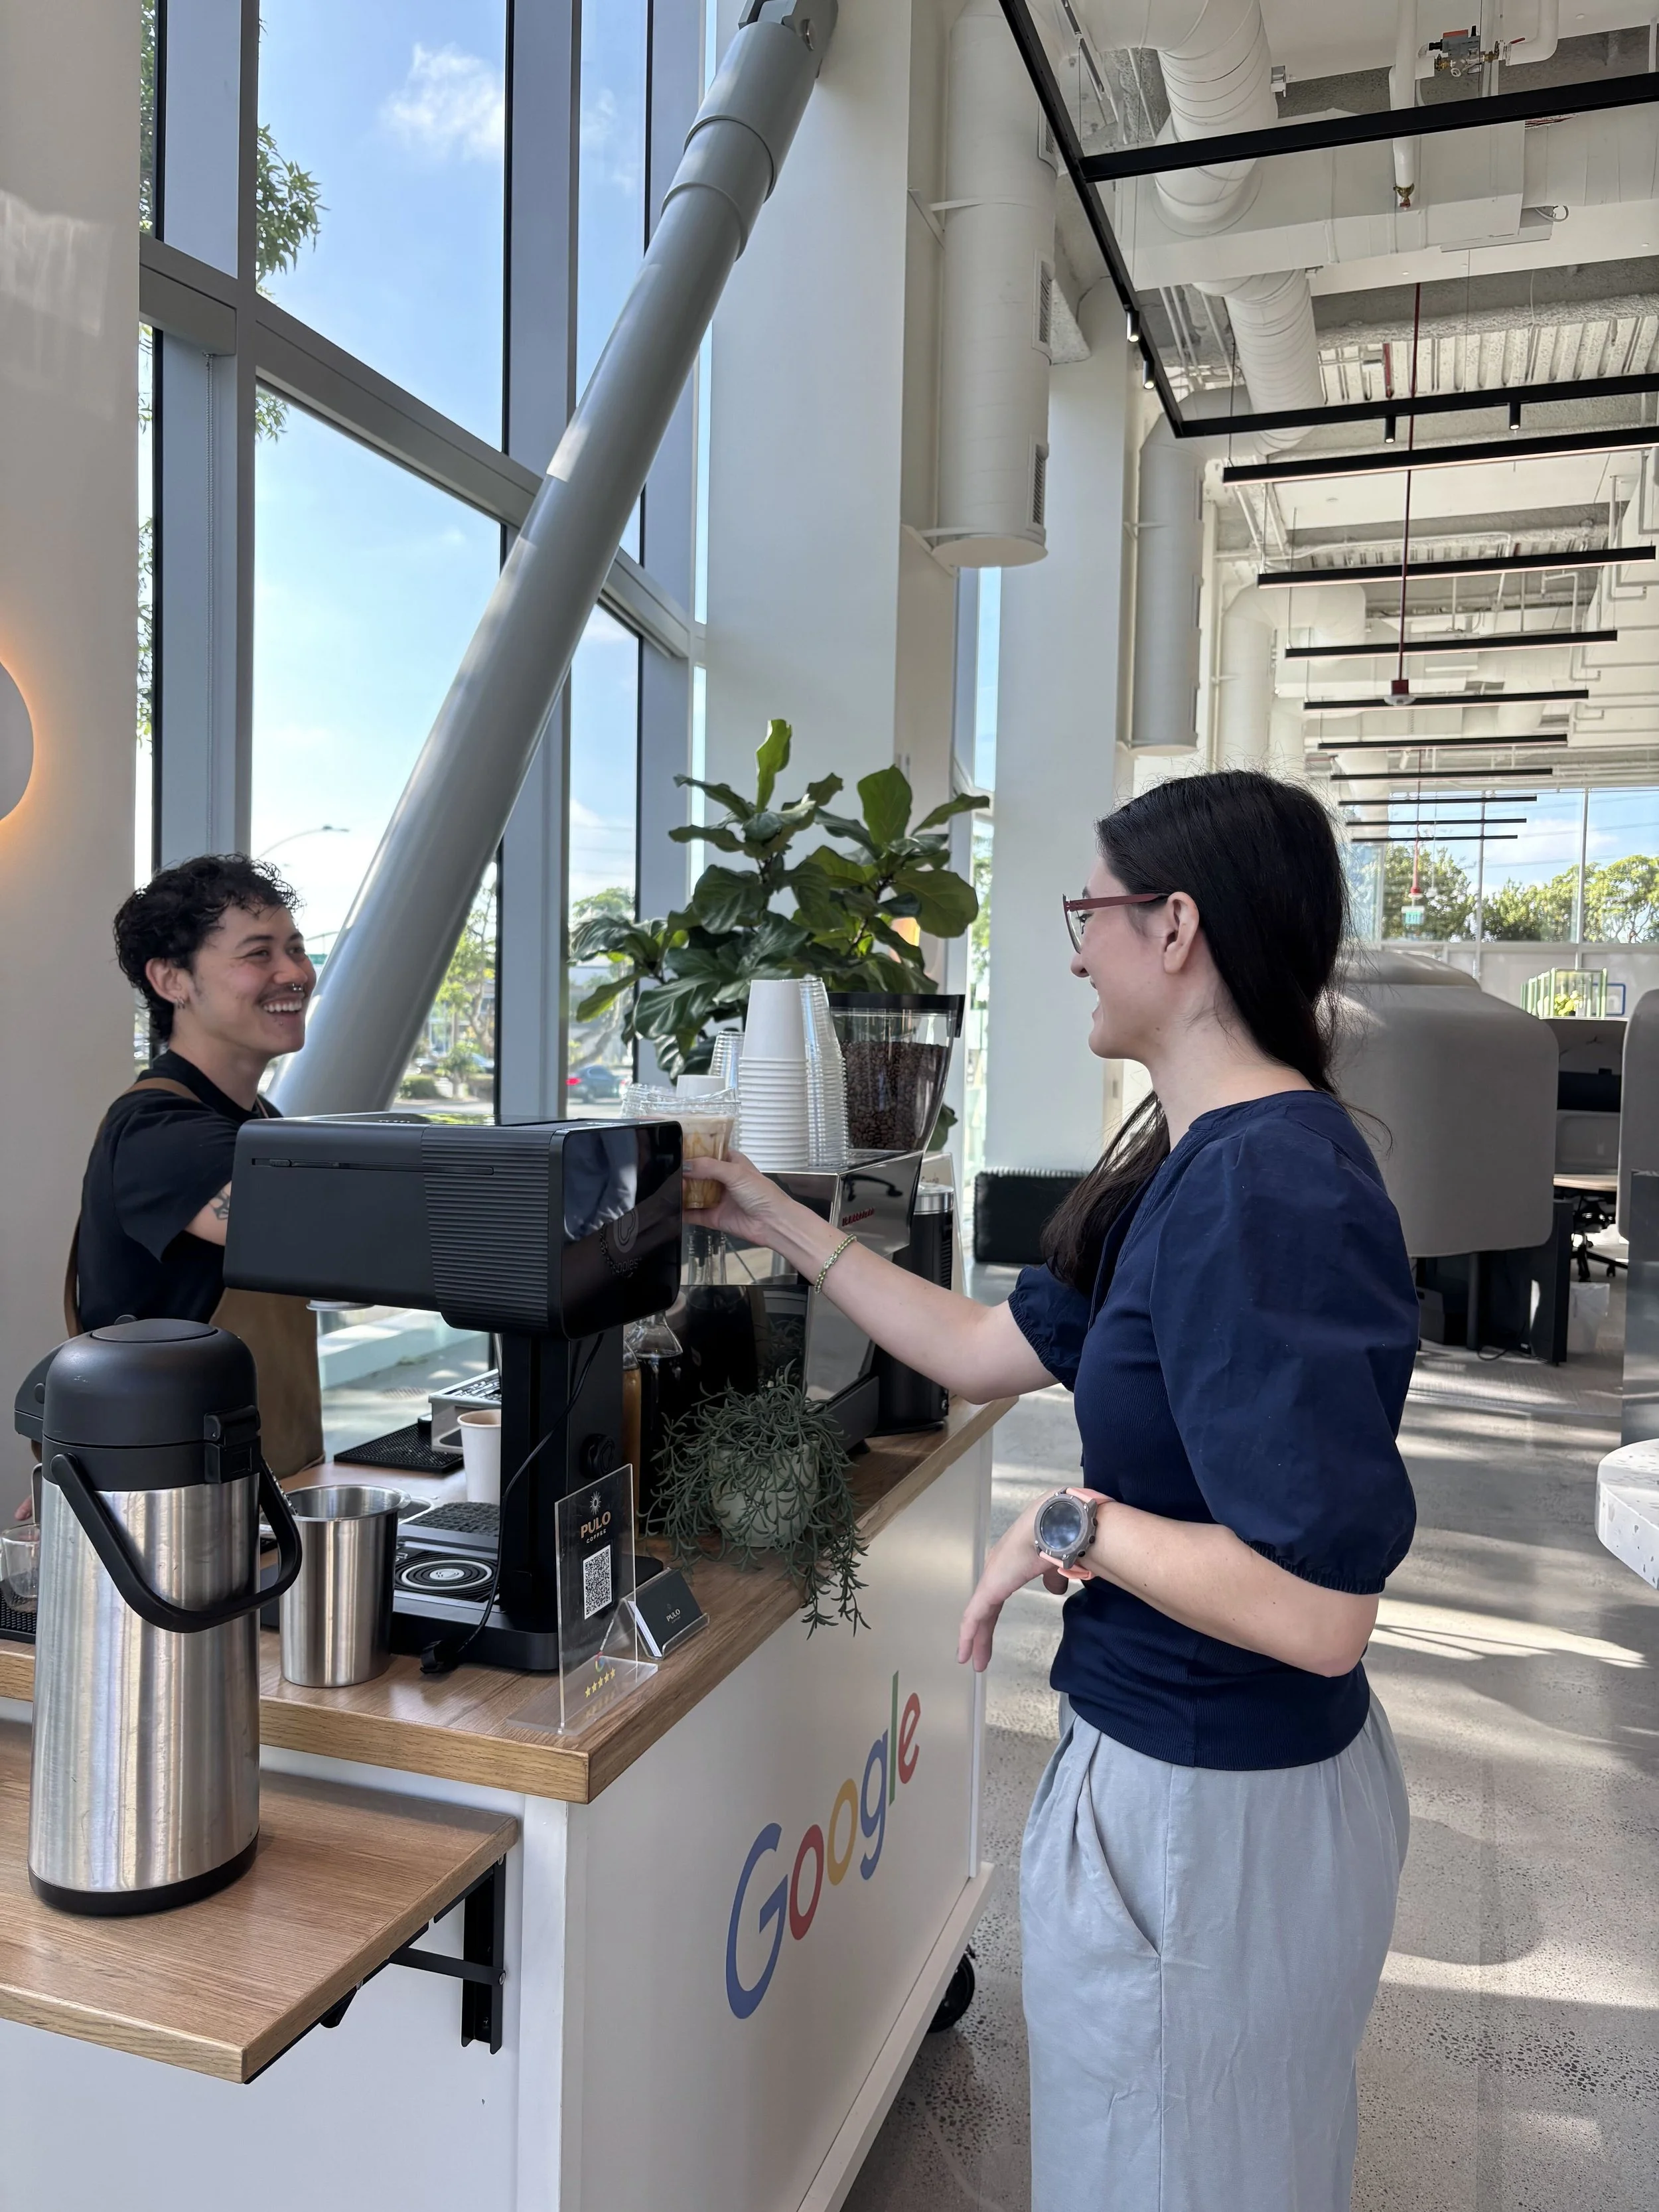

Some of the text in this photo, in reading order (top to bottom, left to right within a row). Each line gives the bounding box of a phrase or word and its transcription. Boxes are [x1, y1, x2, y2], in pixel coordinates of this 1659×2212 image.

[581, 1511, 611, 1538] PULO
[586, 1528, 607, 1544] COFFEE
[666, 1609, 681, 1622] PULO
[726, 1670, 921, 2019] Google
